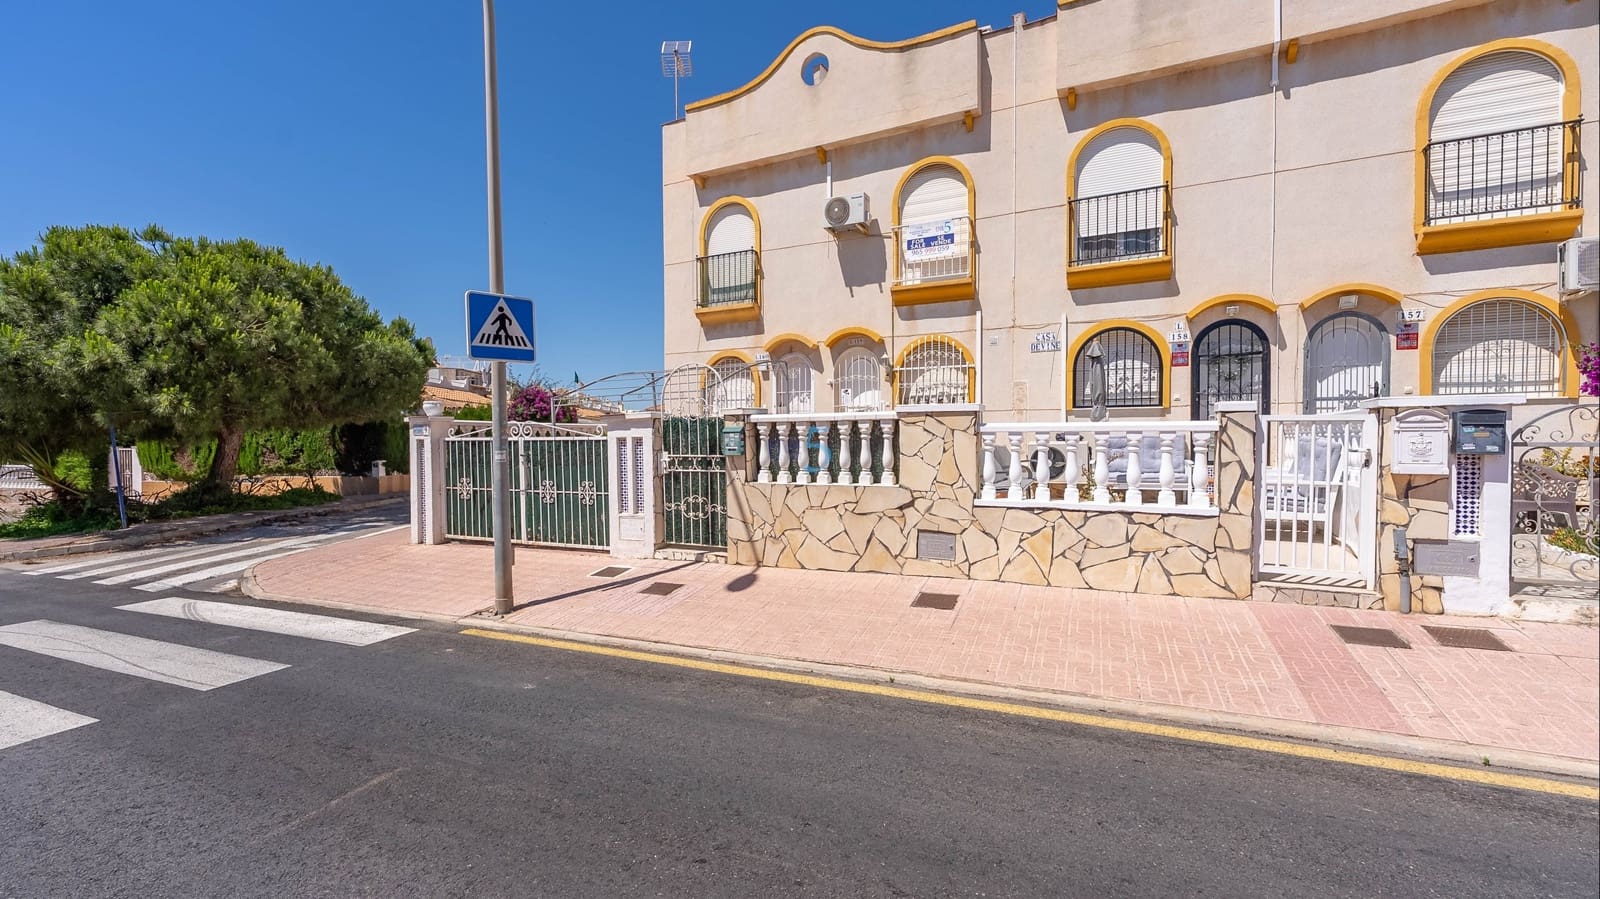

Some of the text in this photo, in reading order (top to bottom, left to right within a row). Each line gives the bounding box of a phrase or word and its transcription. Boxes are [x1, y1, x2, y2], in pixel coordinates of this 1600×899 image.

[1401, 310, 1421, 319] 157
[1035, 332, 1056, 340] CASA
[1030, 342, 1061, 351] DEVINE
